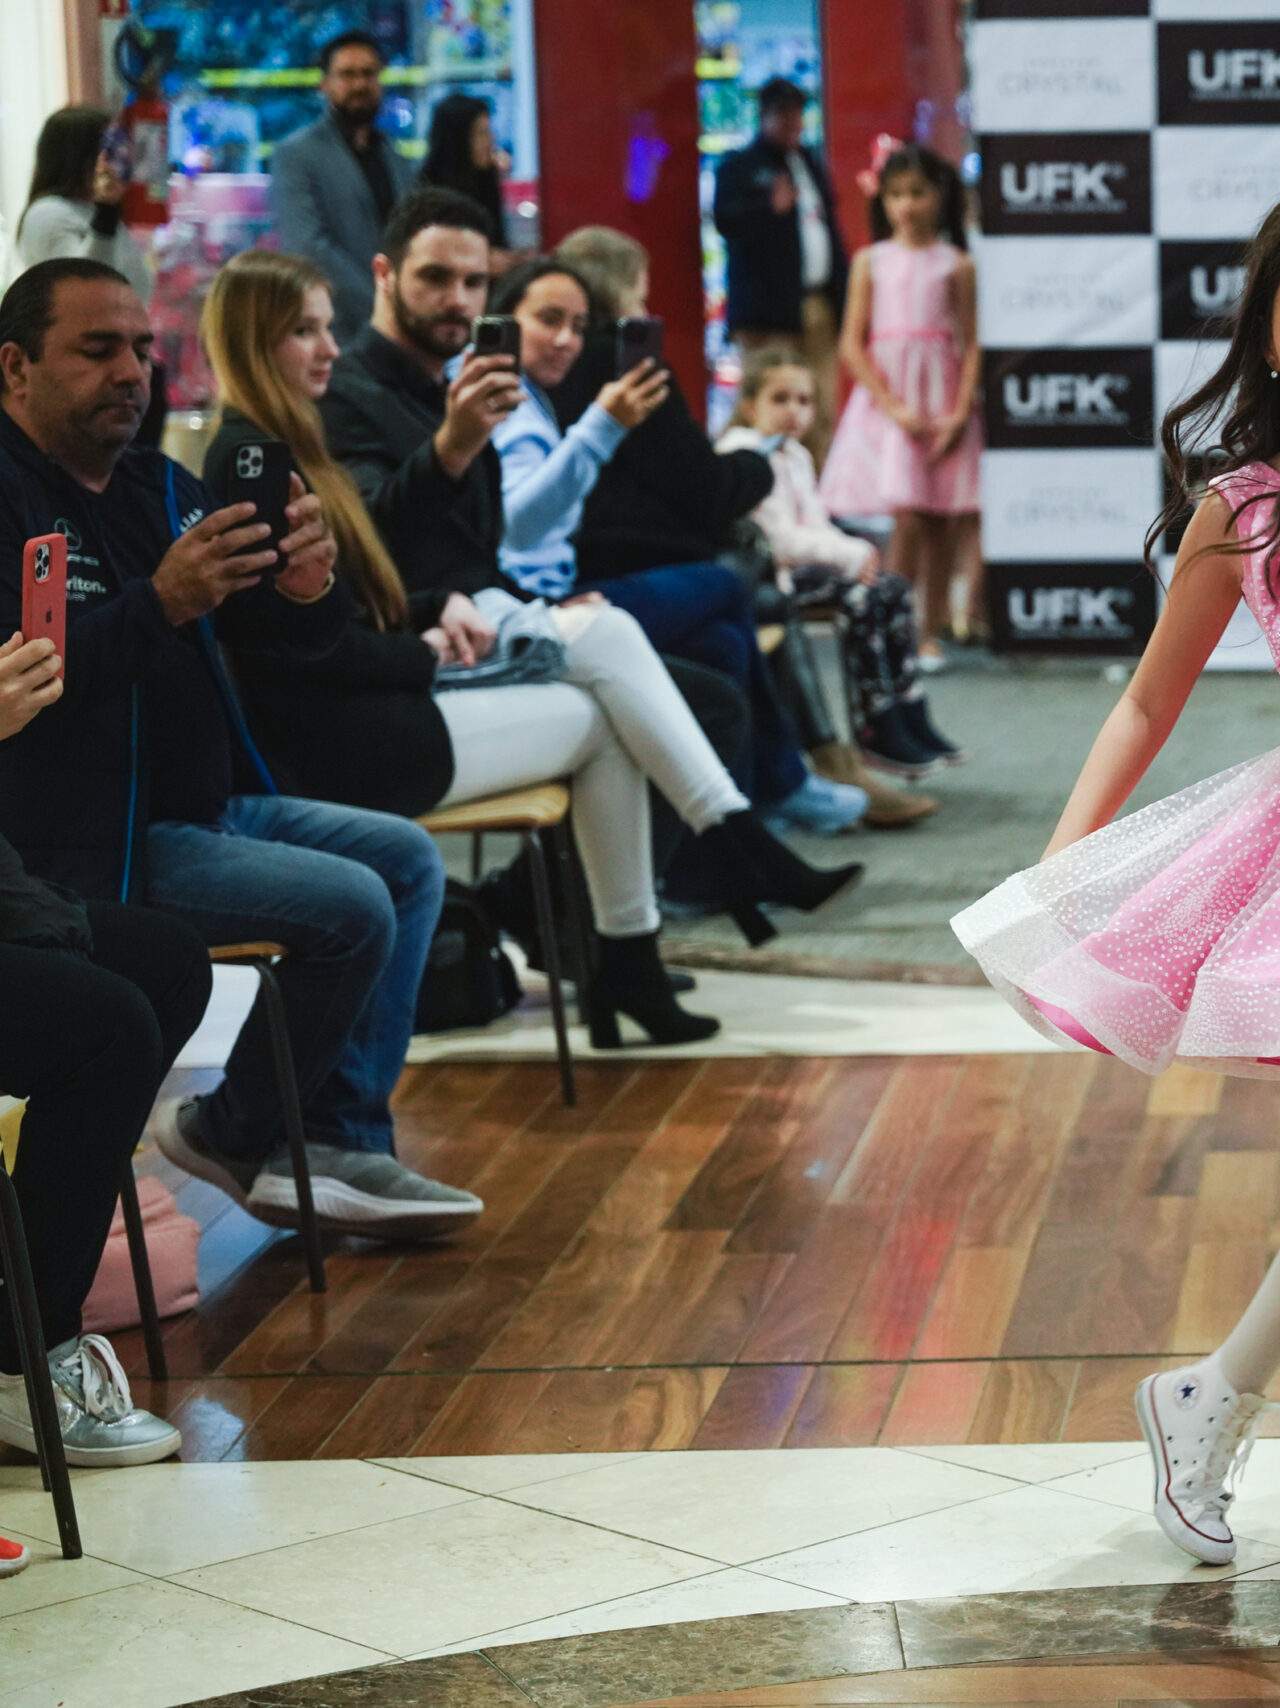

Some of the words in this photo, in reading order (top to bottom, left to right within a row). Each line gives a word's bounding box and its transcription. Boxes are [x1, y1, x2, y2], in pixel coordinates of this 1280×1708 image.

[1001, 161, 1114, 203] UFK
[1003, 373, 1116, 418] UFK
[1007, 587, 1118, 632] UFK
